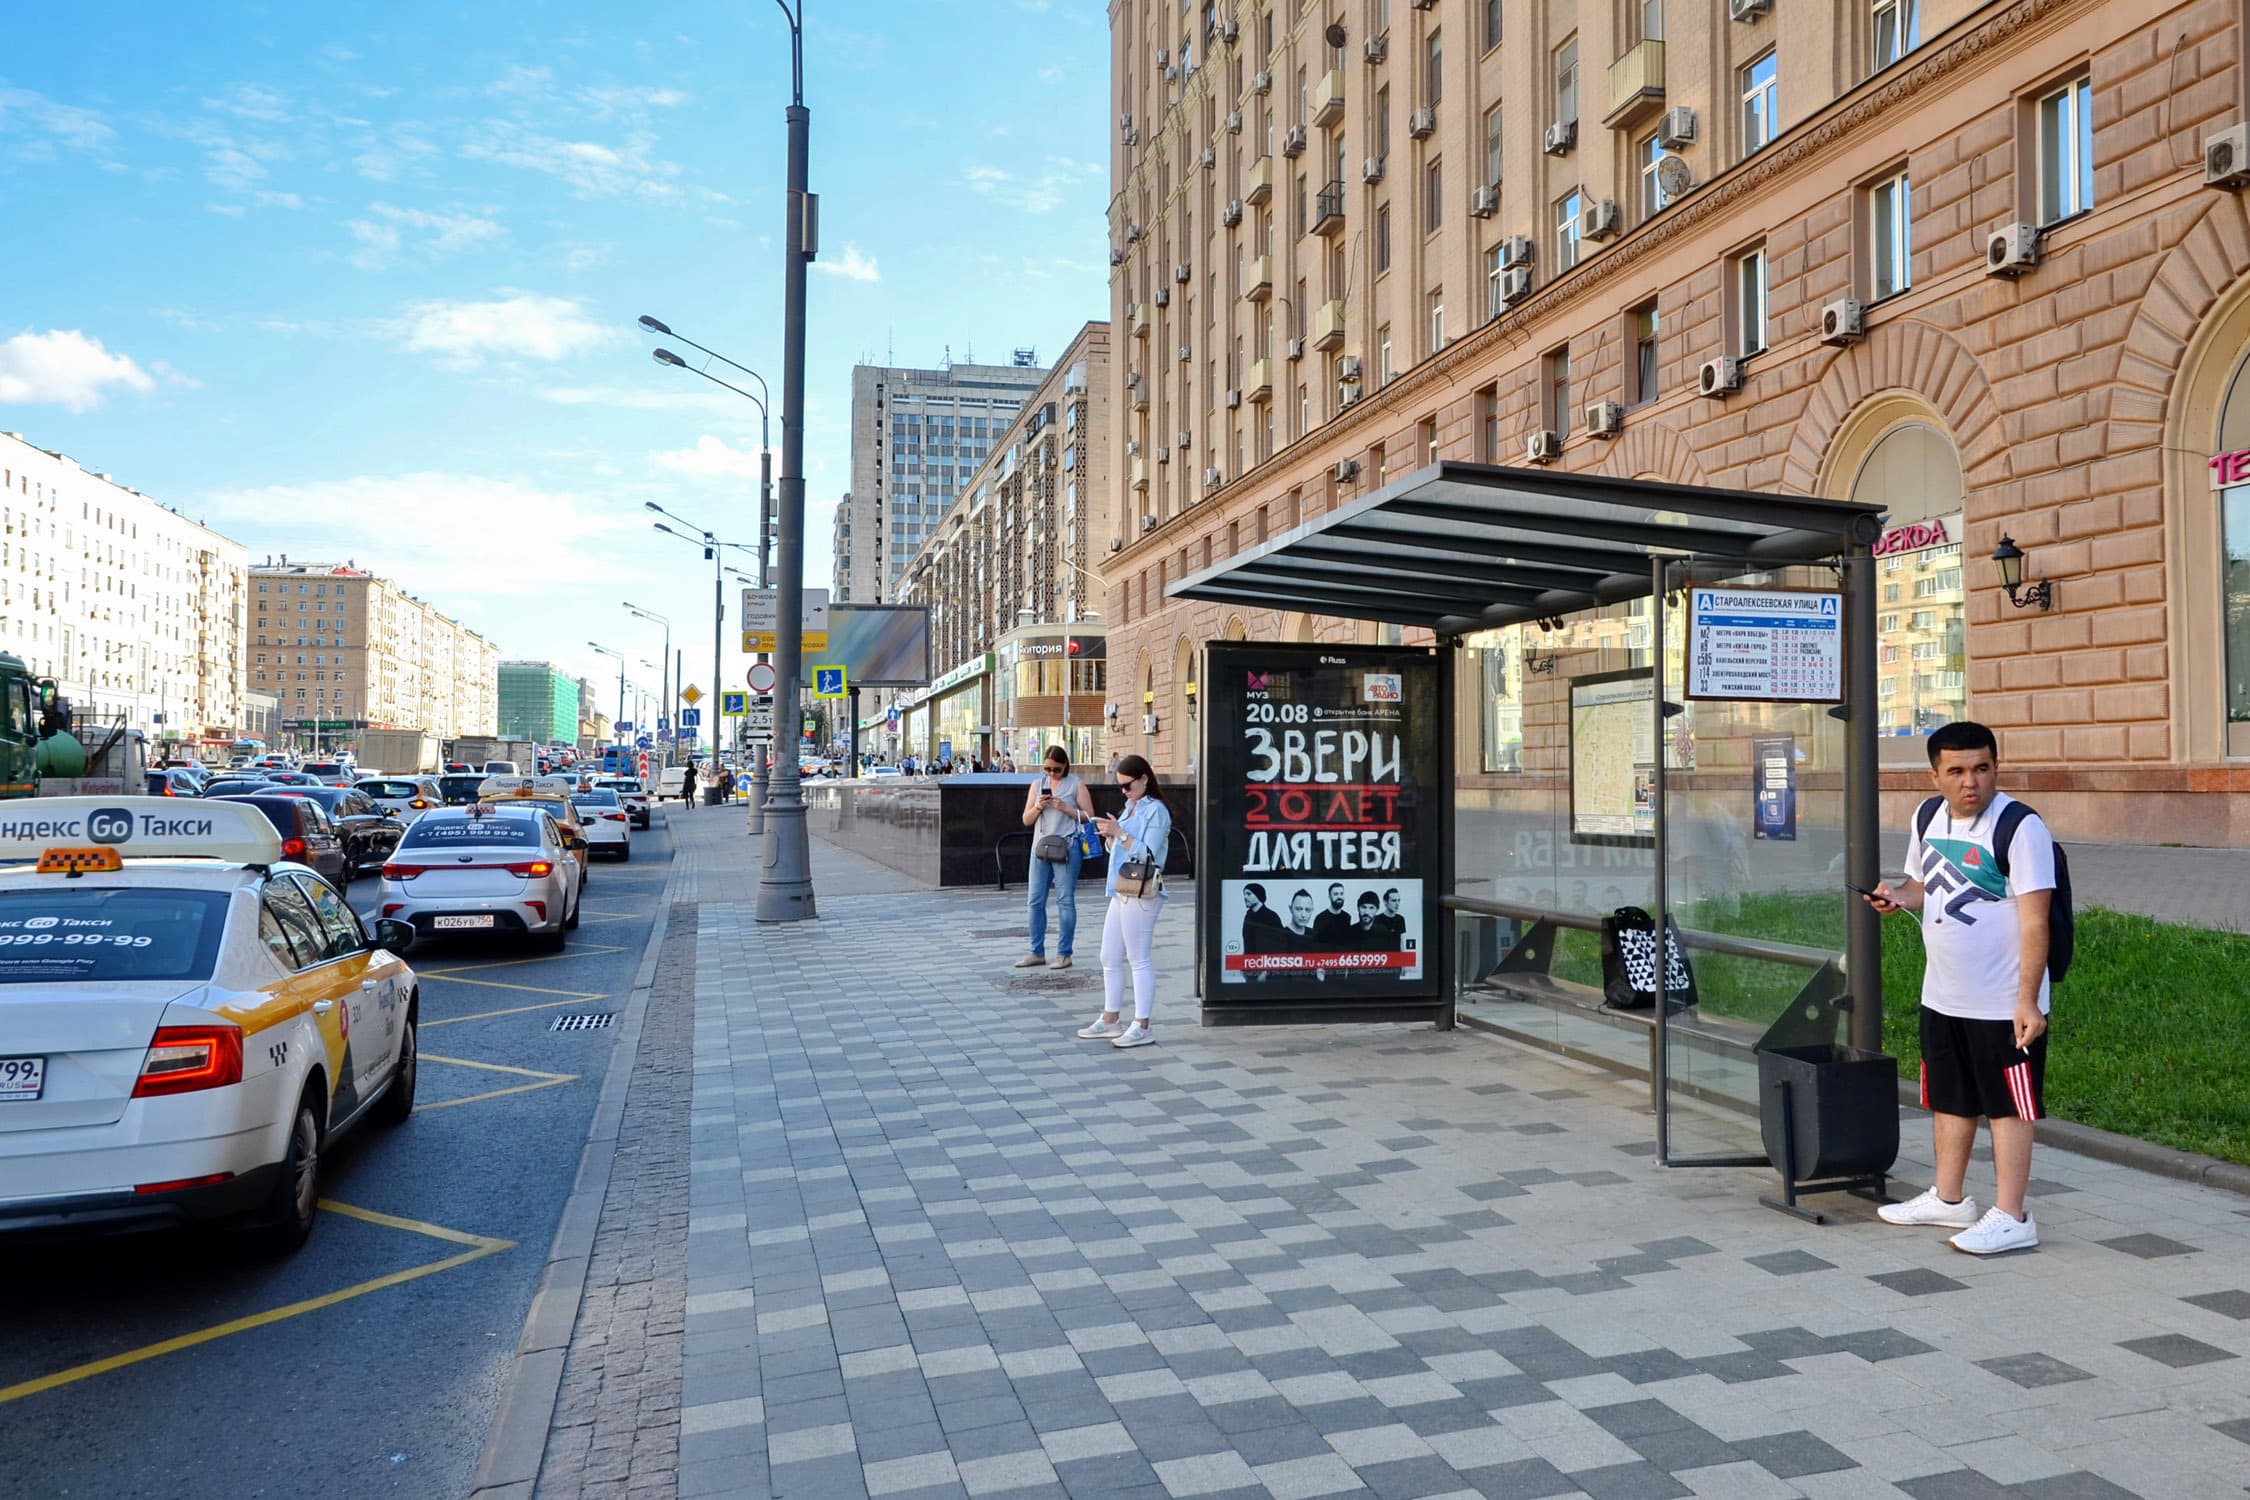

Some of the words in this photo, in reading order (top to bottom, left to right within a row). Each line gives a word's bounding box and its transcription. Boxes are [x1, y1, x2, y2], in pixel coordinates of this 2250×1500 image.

[1872, 517, 1949, 556] ДЕЖДА
[1714, 596, 1792, 609] СТАРОАЛЕКСЕЕВСКАЯ
[1793, 599, 1818, 610] УЛИЦА
[1328, 656, 1346, 664] Russ
[1246, 691, 1269, 700] МУЗ
[1246, 703, 1309, 724] 20.08
[1374, 708, 1400, 716] АРЕНА
[1244, 727, 1400, 783] ЗВЕРИ
[1245, 789, 1313, 823] 20
[1325, 790, 1399, 823] ЛЕТ
[91, 814, 130, 838] Go
[139, 814, 213, 837] Такси
[1242, 831, 1312, 872] ДЛЯ
[1316, 831, 1400, 871] ТЕБЯ
[61, 917, 113, 927] Такси
